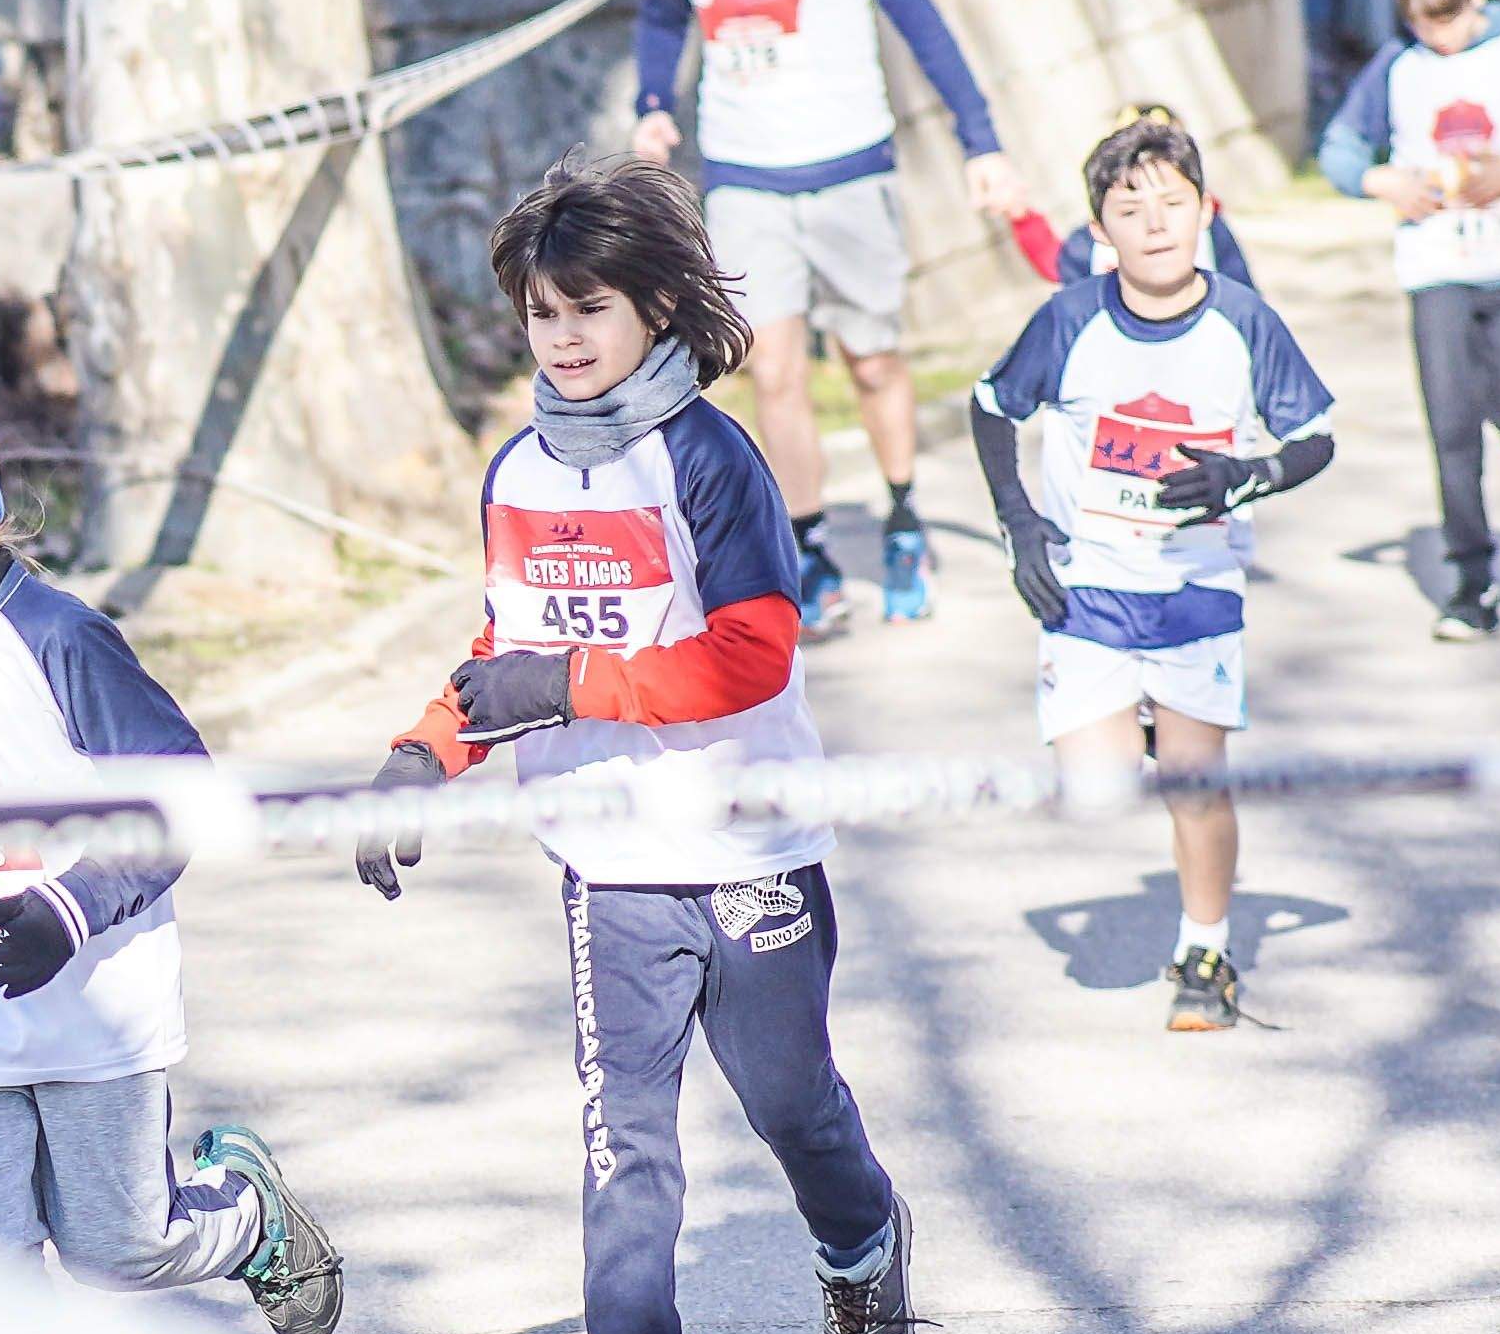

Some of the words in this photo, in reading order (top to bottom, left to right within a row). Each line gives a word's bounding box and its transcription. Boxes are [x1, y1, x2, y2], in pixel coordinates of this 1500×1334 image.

[573, 559, 633, 587] MAGOS
[541, 595, 629, 639] 455
[755, 930, 792, 948] DINO
[590, 1126, 618, 1192] REX
